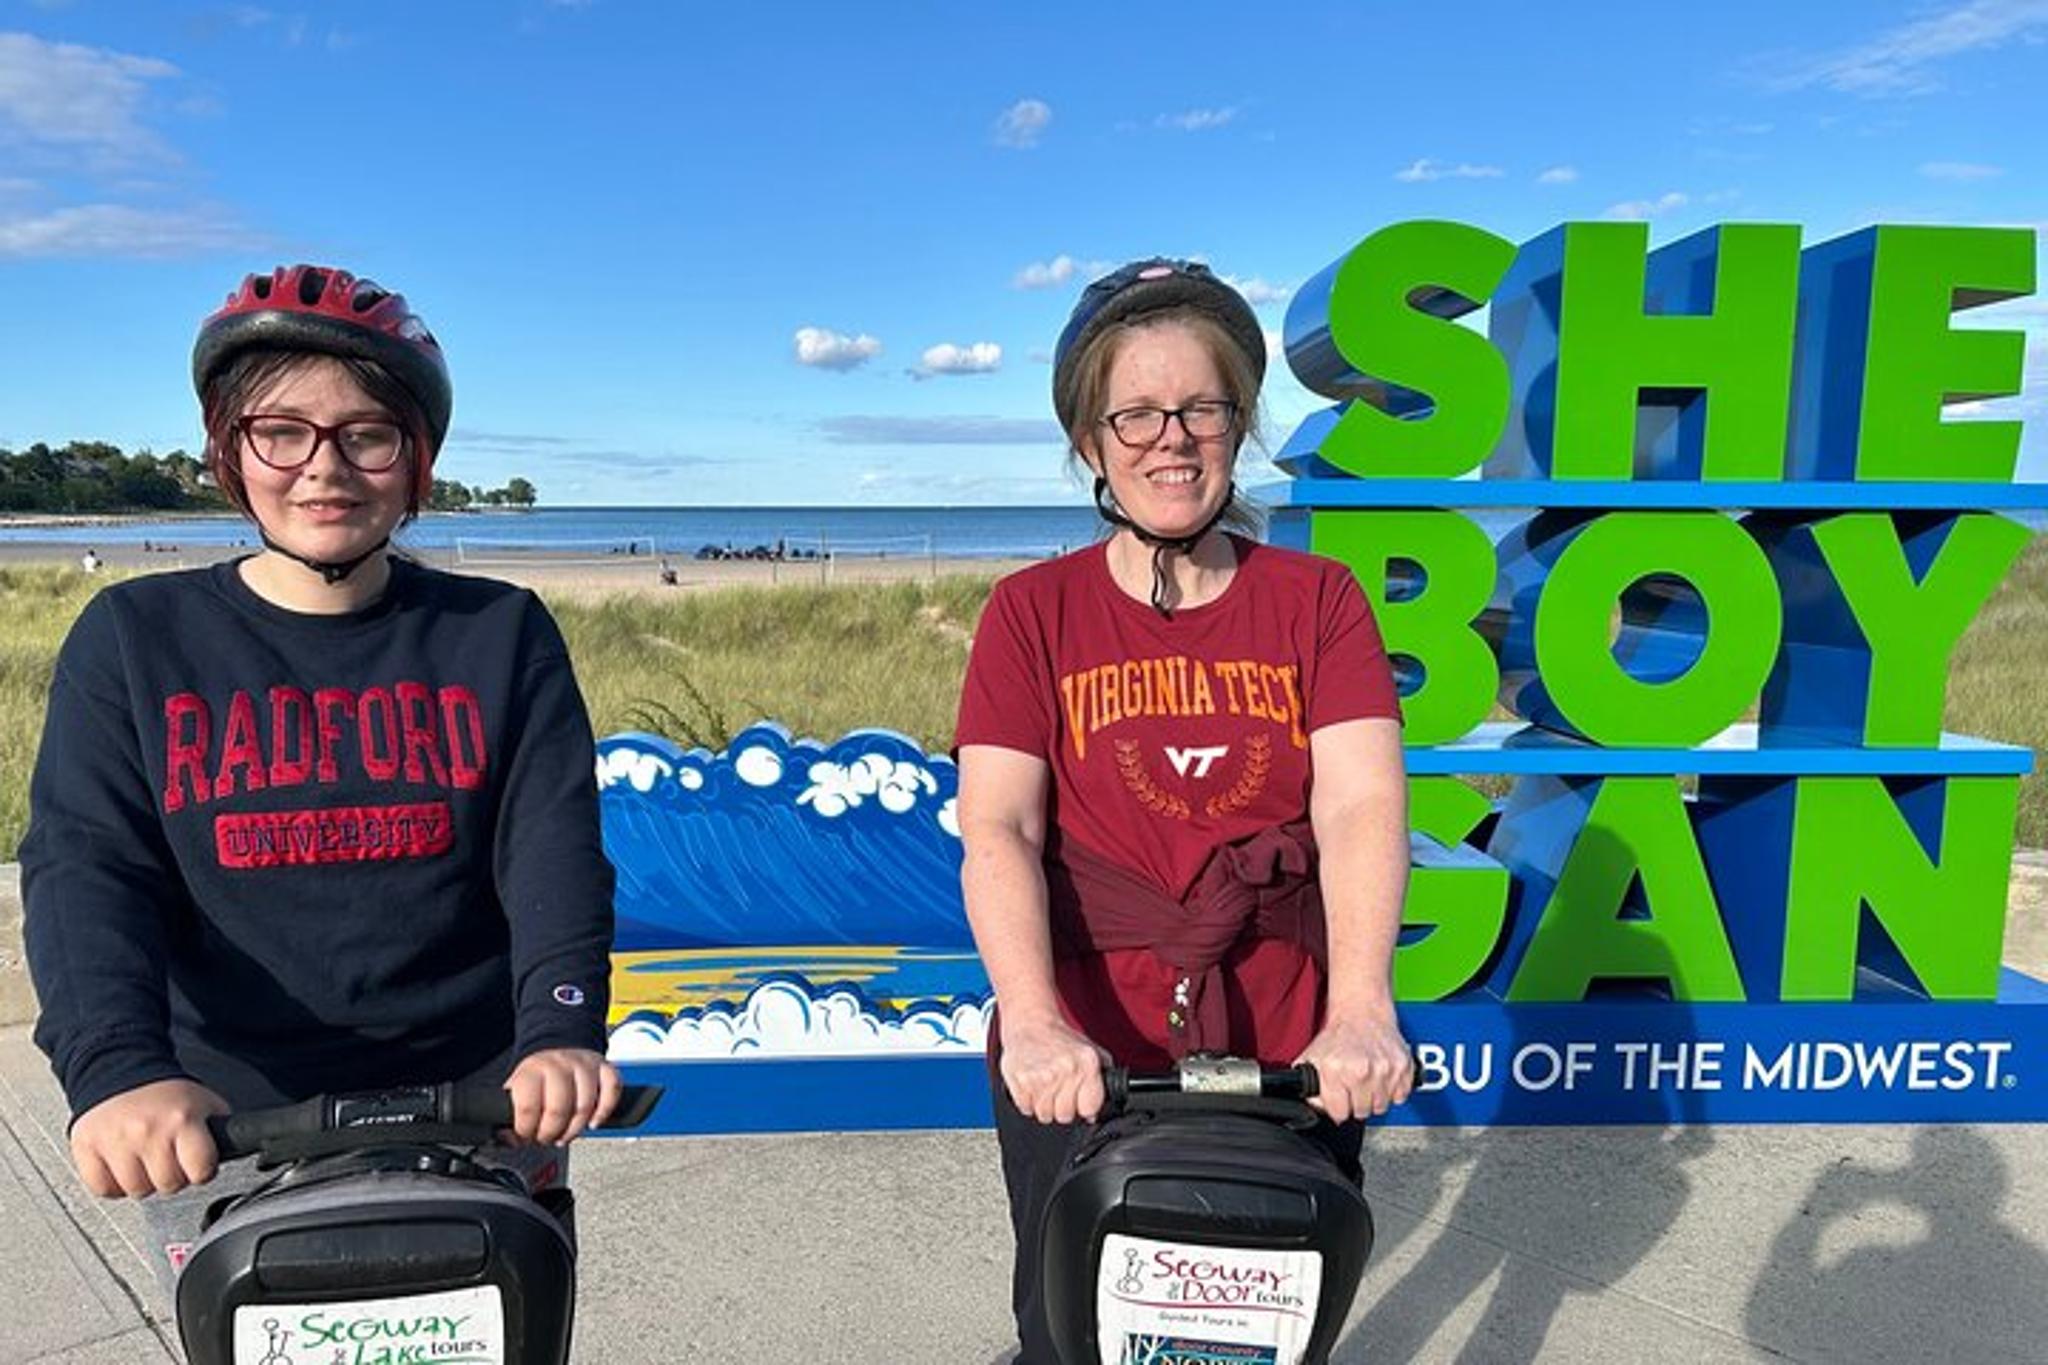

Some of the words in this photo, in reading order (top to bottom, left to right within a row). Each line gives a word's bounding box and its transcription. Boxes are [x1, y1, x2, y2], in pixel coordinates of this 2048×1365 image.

[1315, 218, 2036, 482] SHE
[1311, 509, 2036, 749] BOY
[164, 681, 487, 814] RADFORD
[1061, 656, 1216, 761] VIRGINIA
[1163, 745, 1229, 778] VT
[227, 816, 440, 854] UNIVERSITY
[1415, 1042, 1493, 1093] BU
[1512, 1043, 1596, 1091] OF
[1614, 1043, 1725, 1091] THE
[431, 1339, 488, 1356] tours
